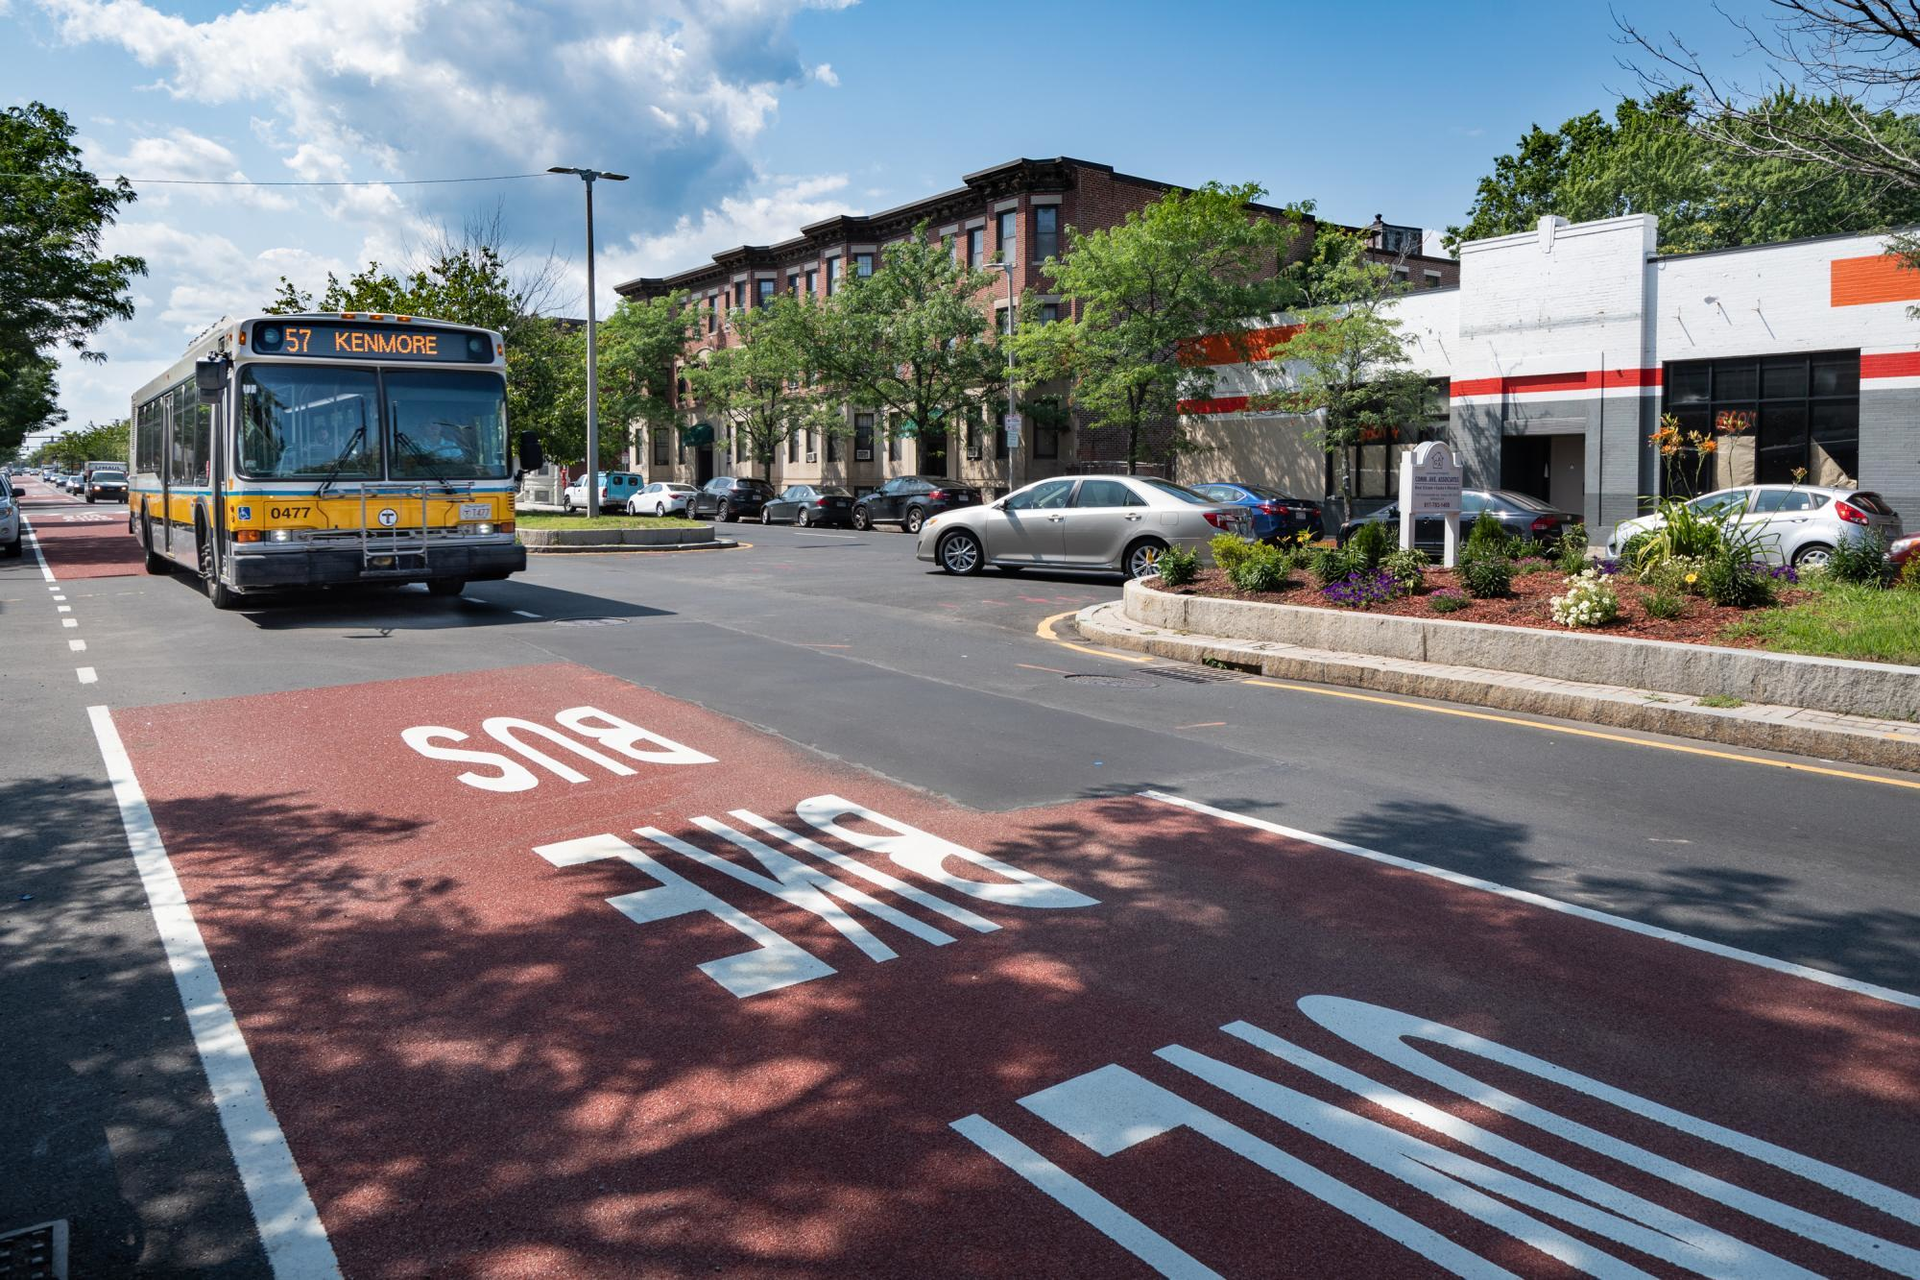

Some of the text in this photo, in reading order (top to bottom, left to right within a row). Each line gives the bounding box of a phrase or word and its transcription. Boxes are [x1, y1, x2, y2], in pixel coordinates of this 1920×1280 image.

[284, 328, 438, 355] 57 KENMORE
[271, 507, 311, 519] 0477
[381, 512, 394, 524] T
[401, 706, 719, 793] BUS
[533, 793, 1101, 999] BIKE
